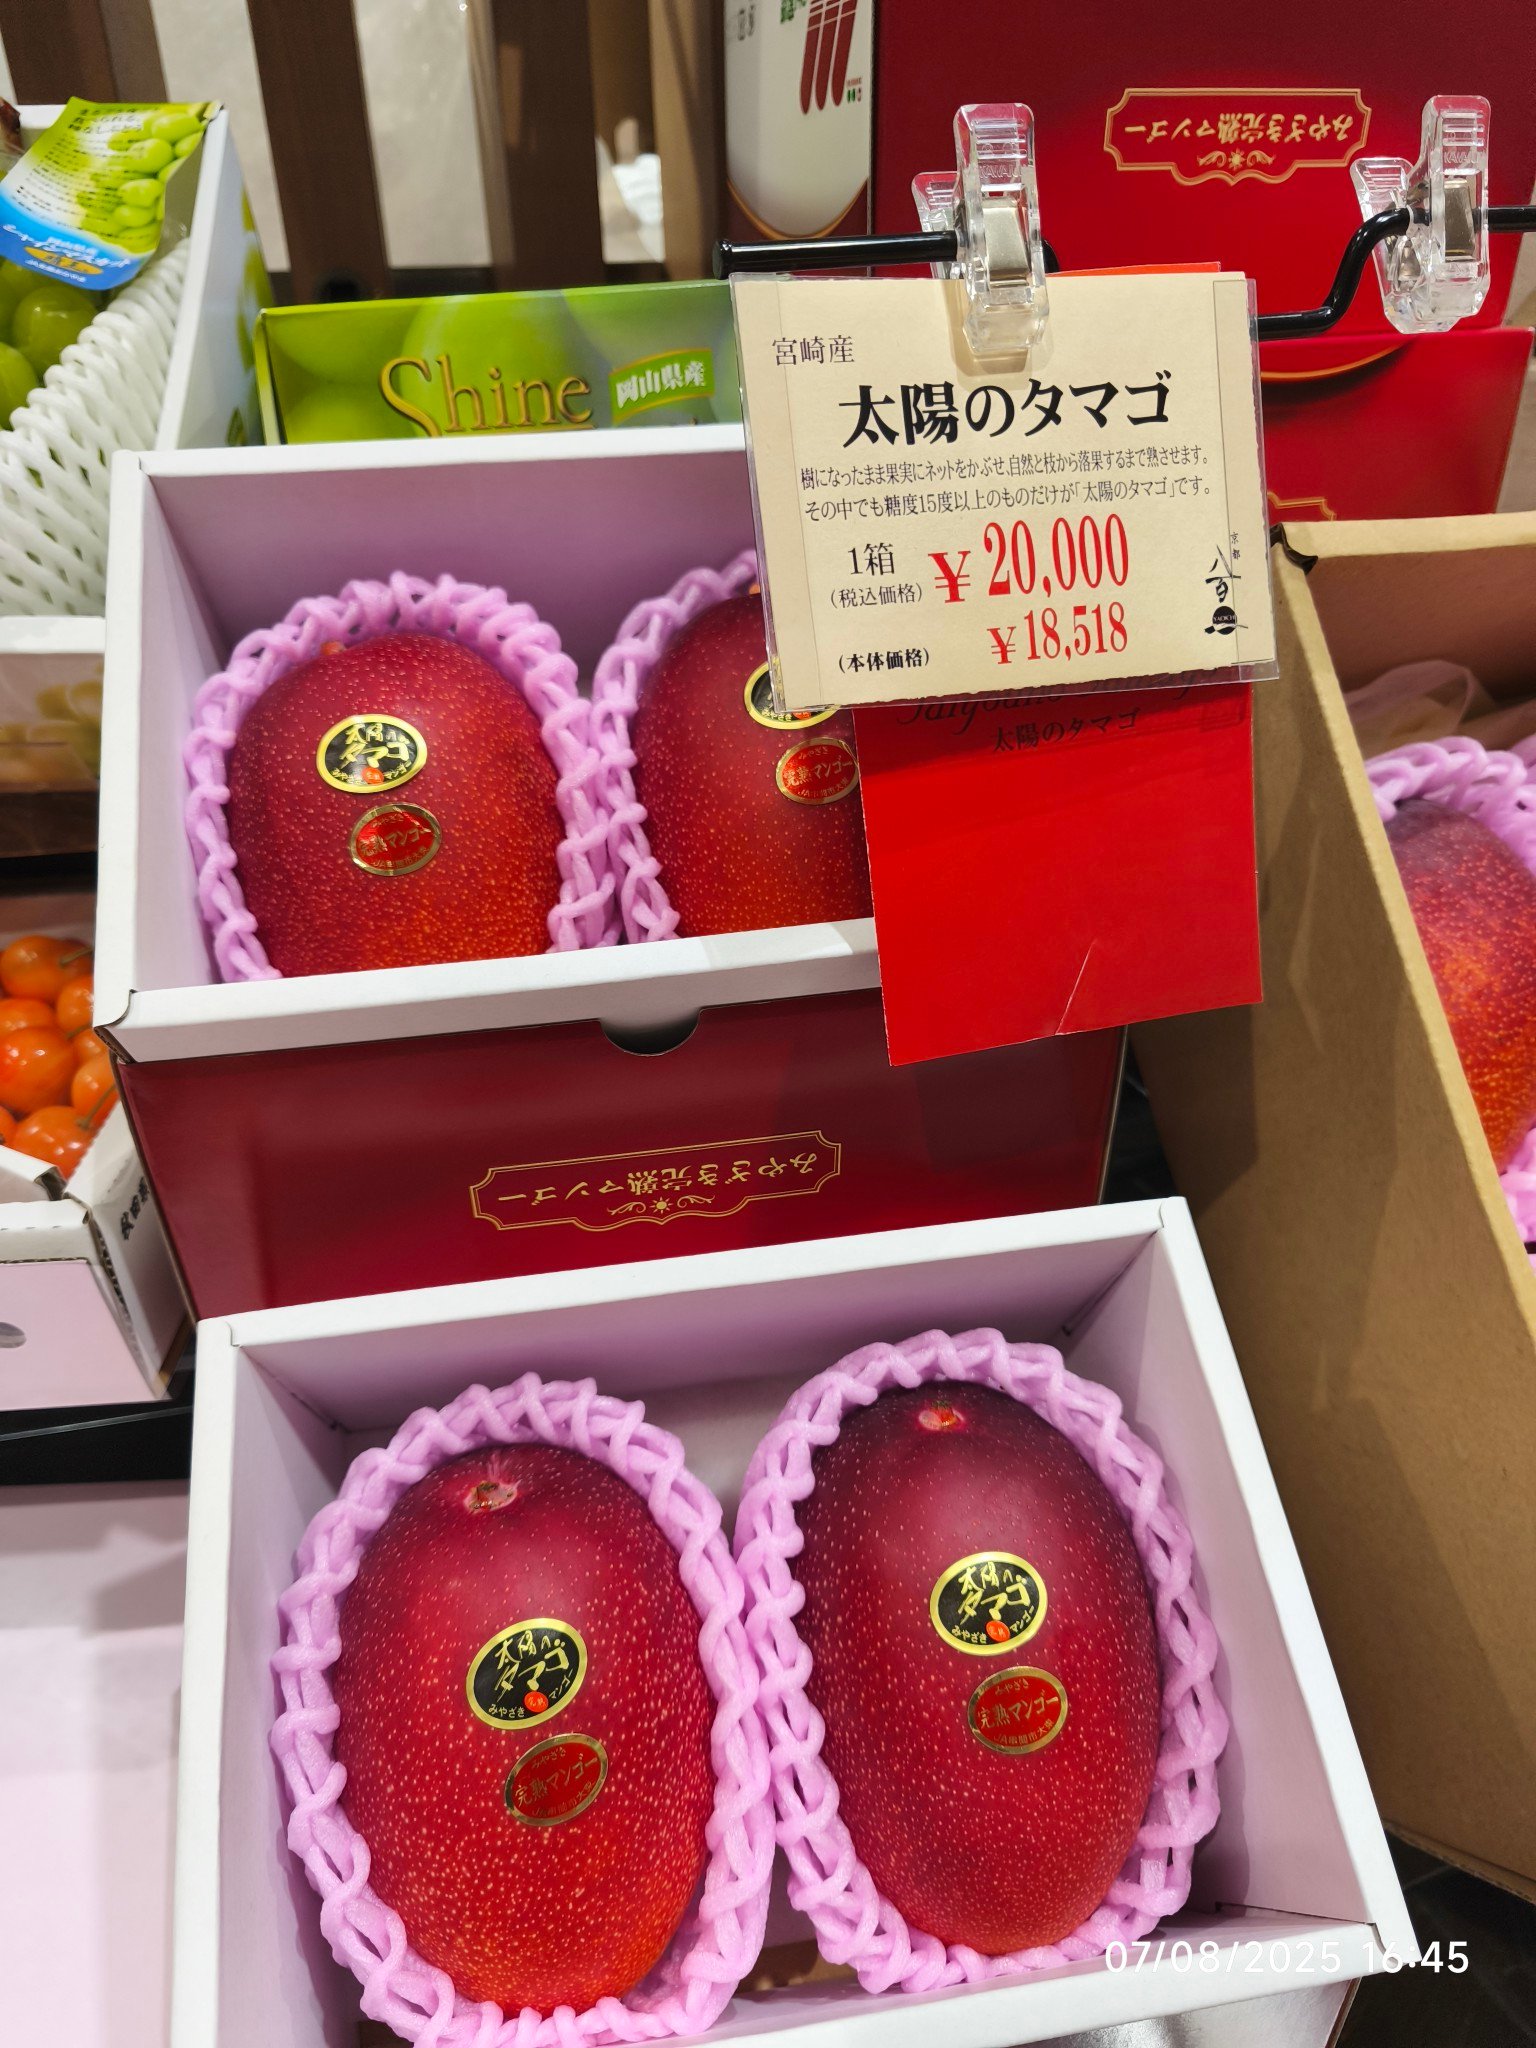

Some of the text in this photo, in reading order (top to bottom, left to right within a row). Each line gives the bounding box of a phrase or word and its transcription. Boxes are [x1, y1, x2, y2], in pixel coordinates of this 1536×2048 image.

[1124, 112, 1353, 144] みやざき完熟マンゴー
[771, 334, 855, 366] 宮崎産
[379, 353, 592, 437] Shine
[616, 360, 705, 408] 岡山県産
[838, 369, 1172, 448] 太陽のタマゴ
[800, 444, 1208, 491] 樹になったまま果実にネットをかぶせ、自然と枝から落果するまで熟させます。
[805, 475, 1210, 521] その中でも糖度15度以上のものだけが「太陽のタマゴ」です。
[847, 542, 896, 576] 1箱
[830, 582, 923, 609] (税込価格)
[838, 647, 930, 673] (本体価格)
[993, 706, 1141, 753] 太陽のタマゴ
[784, 755, 853, 787] 完熟マンゴー
[498, 1152, 817, 1206] みやざき完熟マンゴー
[957, 1574, 1031, 1626] タマゴ
[951, 1624, 987, 1644] みやざき
[1009, 1605, 1035, 1633] マンゴー
[488, 1703, 526, 1719] みやざき
[548, 1668, 574, 1700] マンゴー
[494, 1638, 570, 1703] タマゴ
[994, 1678, 1030, 1696] みやざき
[977, 1690, 1059, 1729] 完熟マンゴー
[515, 1752, 599, 1808] 完熟マンゴー
